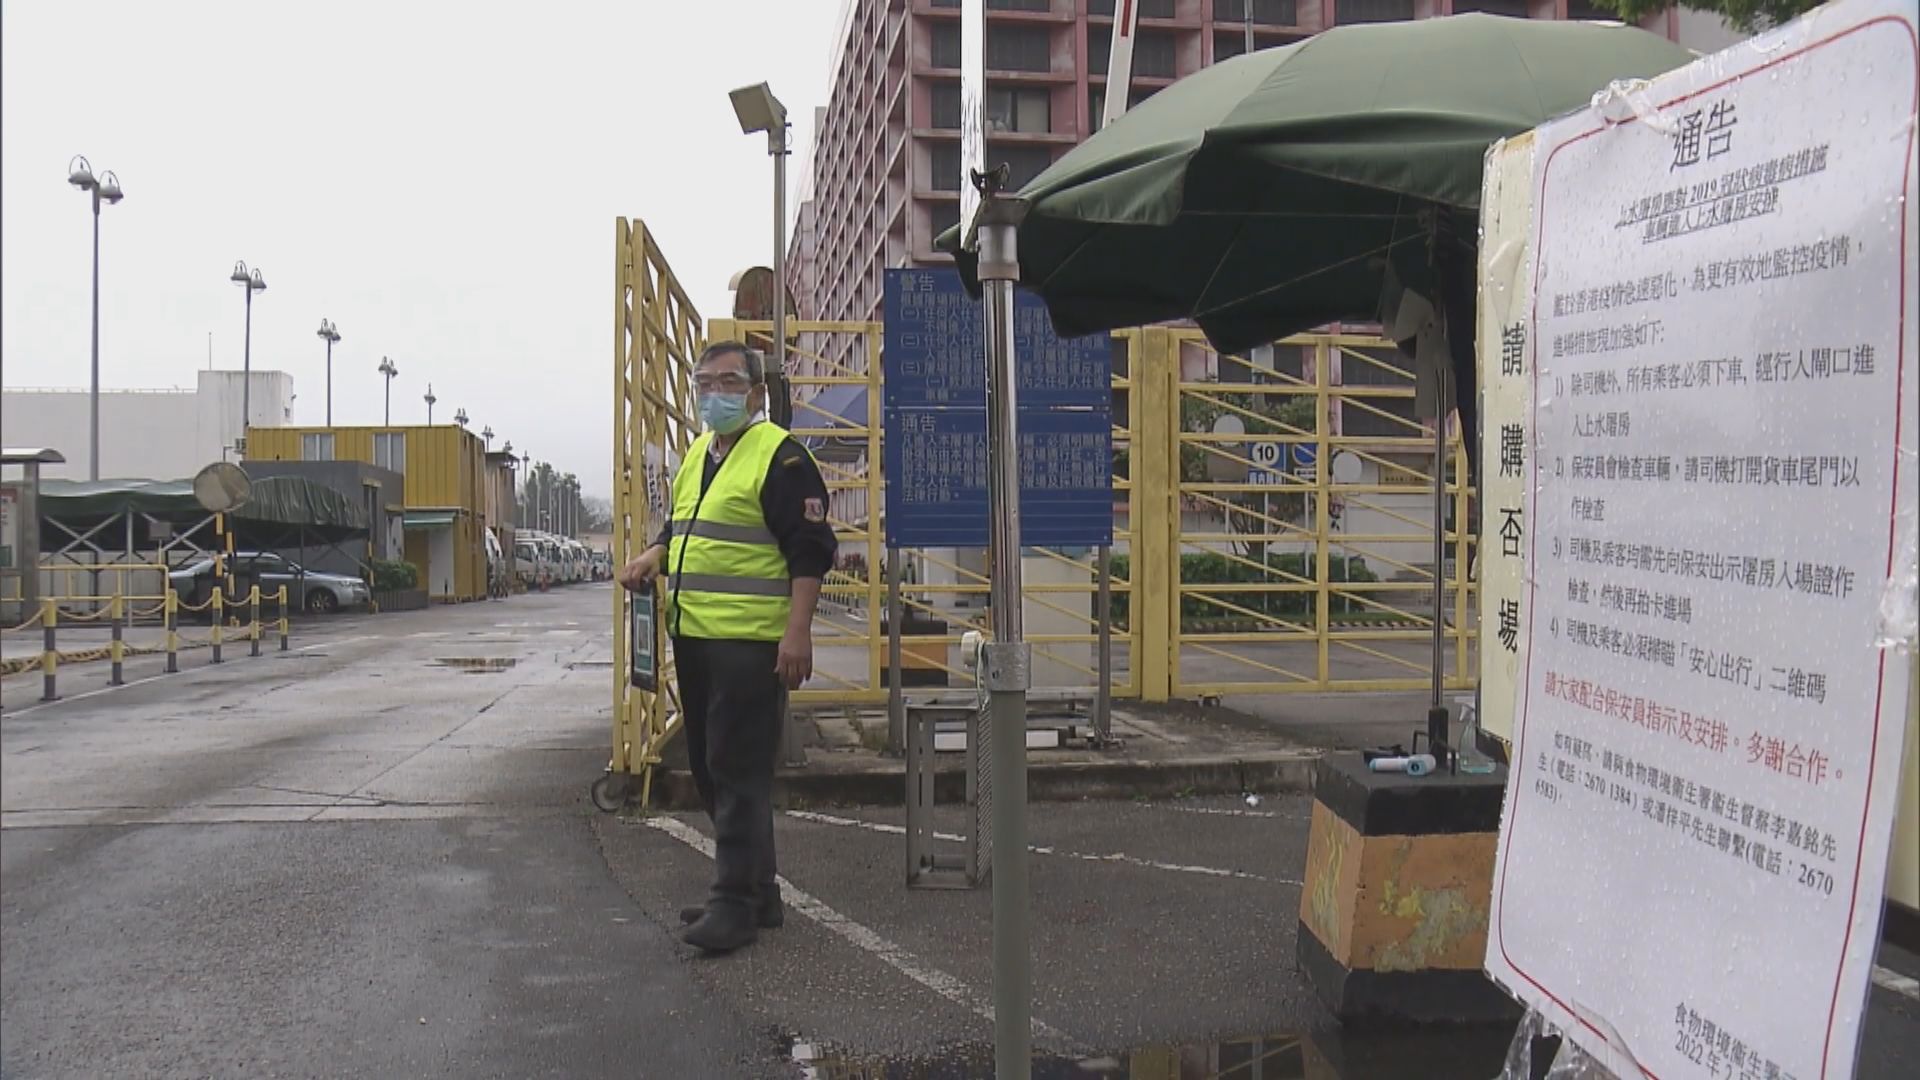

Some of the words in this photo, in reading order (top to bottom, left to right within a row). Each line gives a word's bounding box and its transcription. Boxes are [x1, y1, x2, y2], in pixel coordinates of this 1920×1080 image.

[1669, 98, 1738, 174] 通告
[1690, 178, 1718, 204] 2019
[1755, 343, 1876, 384] 經行人閘口進
[902, 413, 937, 433] 通告
[1257, 445, 1274, 461] 10
[1674, 1030, 1704, 1065] 2022
[1705, 1050, 1721, 1077] 年
